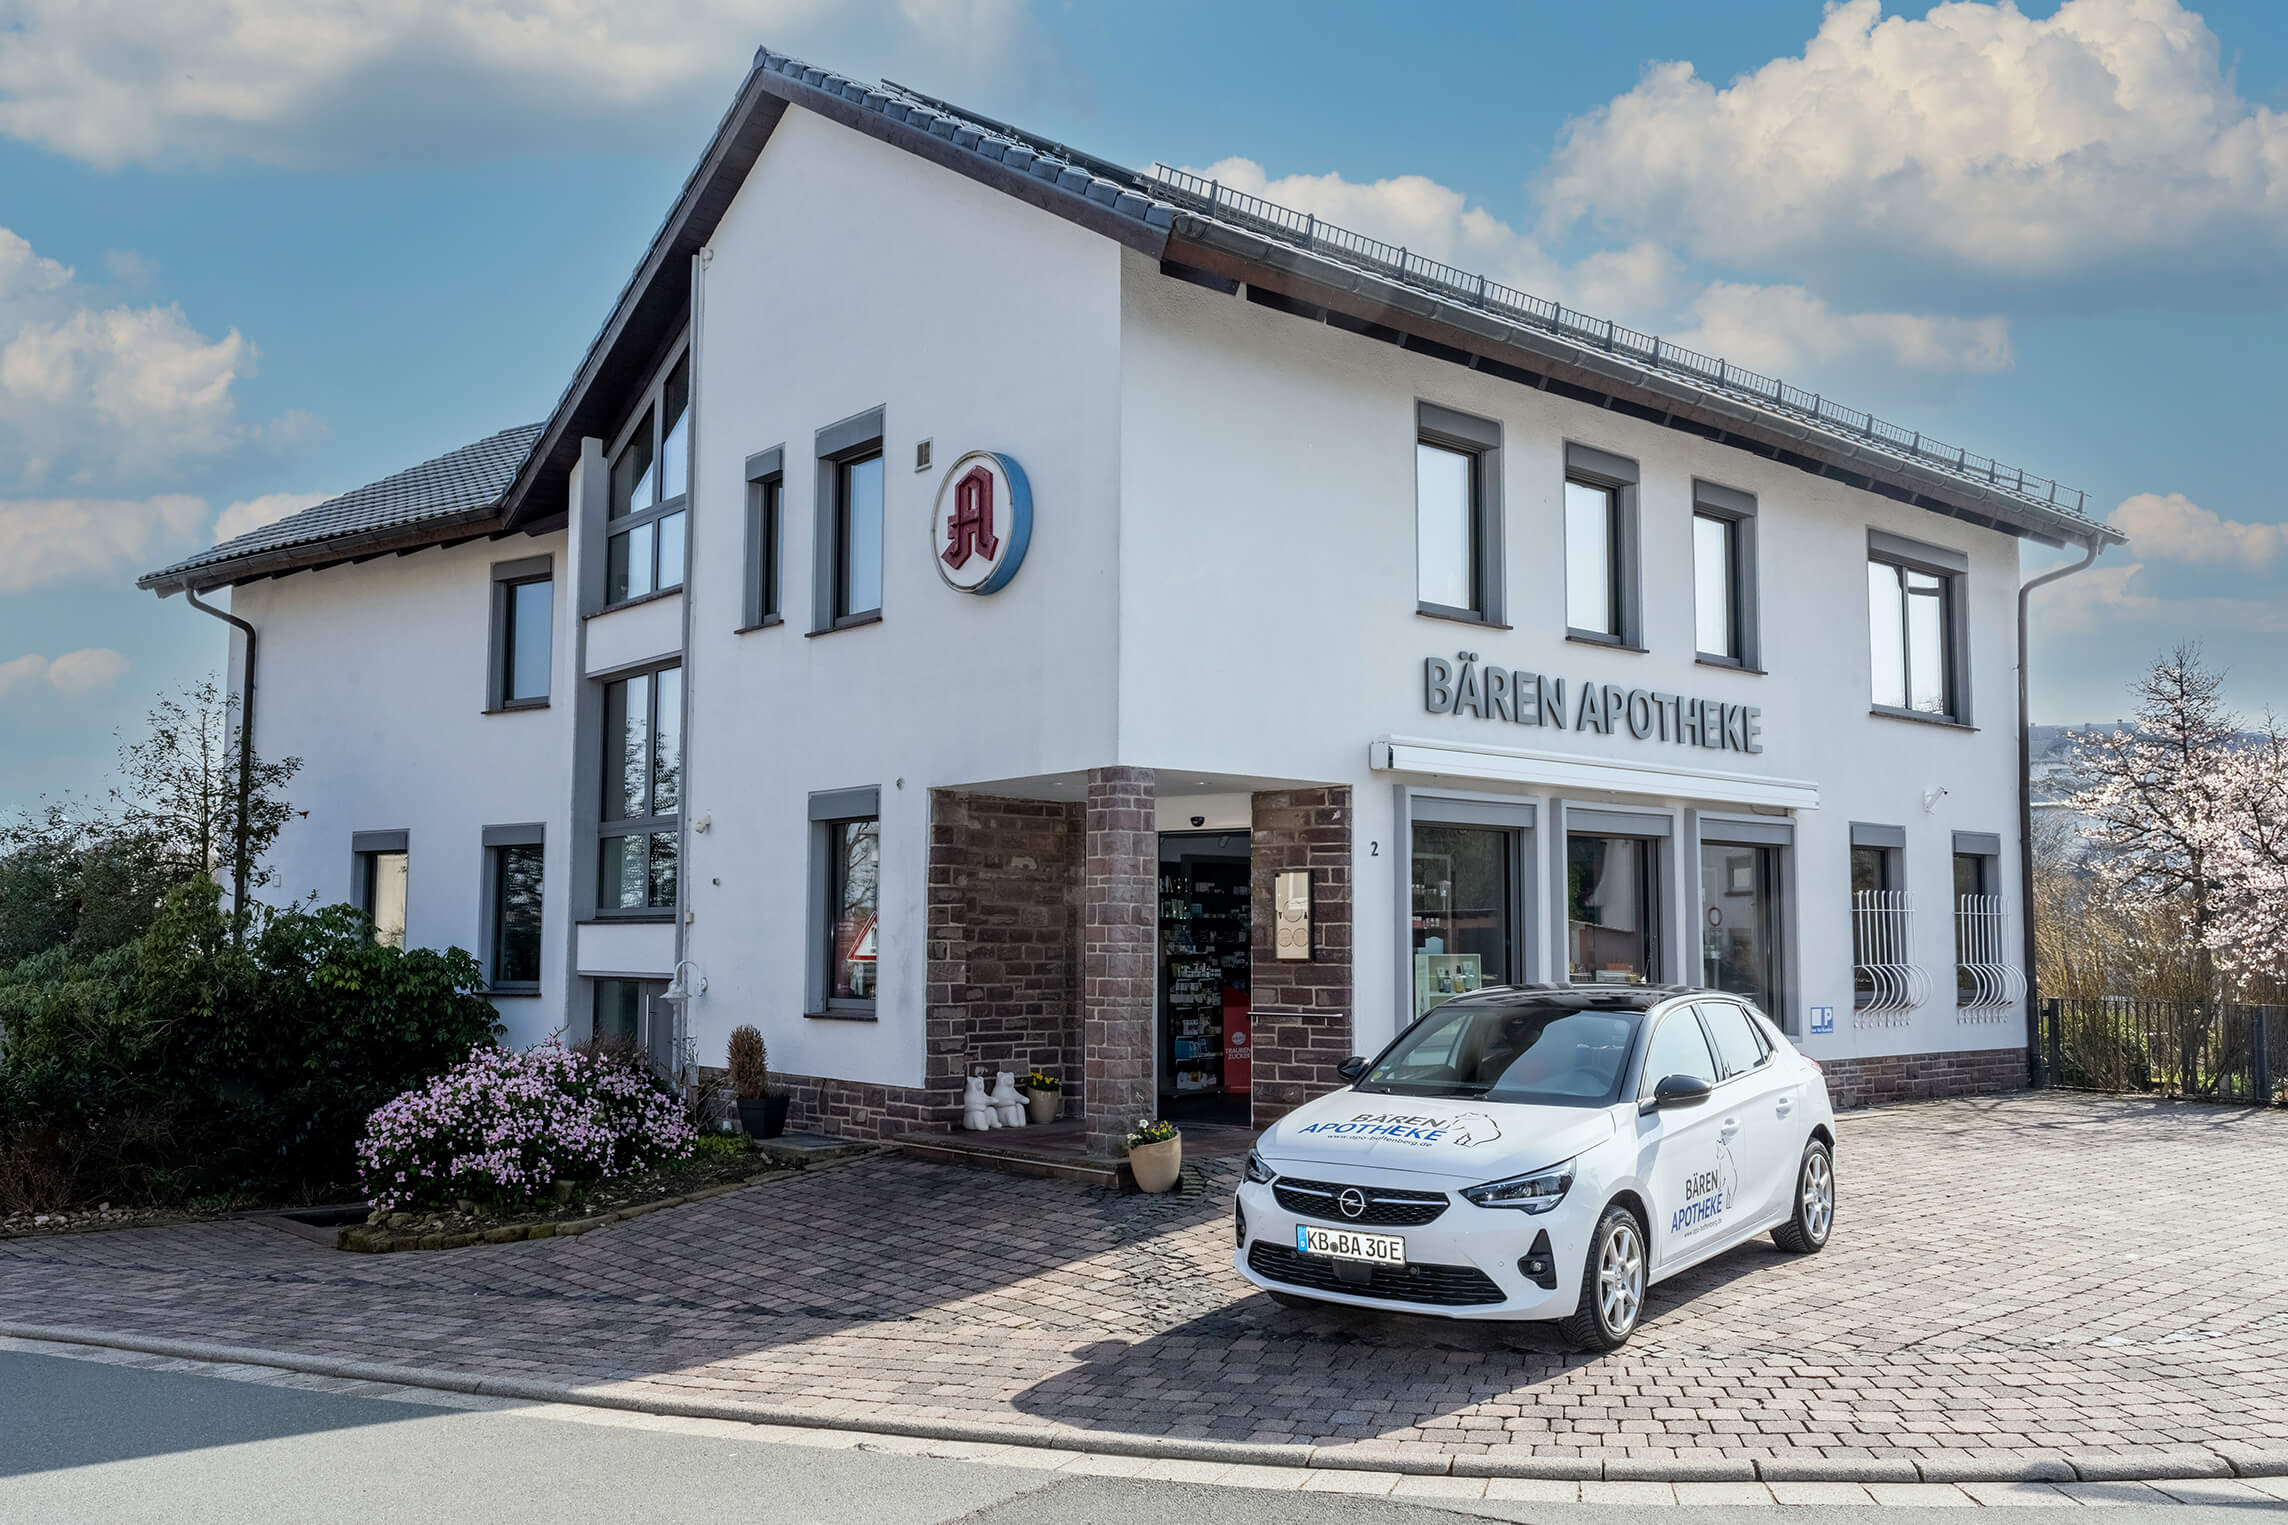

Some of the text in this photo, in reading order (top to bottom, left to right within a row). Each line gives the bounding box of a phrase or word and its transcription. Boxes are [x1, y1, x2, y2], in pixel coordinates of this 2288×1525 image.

[1424, 651, 1763, 754] BÄREN APOTHEKE
[1370, 841, 1378, 856] 2
[1824, 1008, 1832, 1026] P
[1350, 1113, 1447, 1128] BÄREN
[1297, 1123, 1447, 1142] APOTHEKE
[1685, 1169, 1718, 1201] BÄREN
[1671, 1193, 1723, 1234] APOTHEKE
